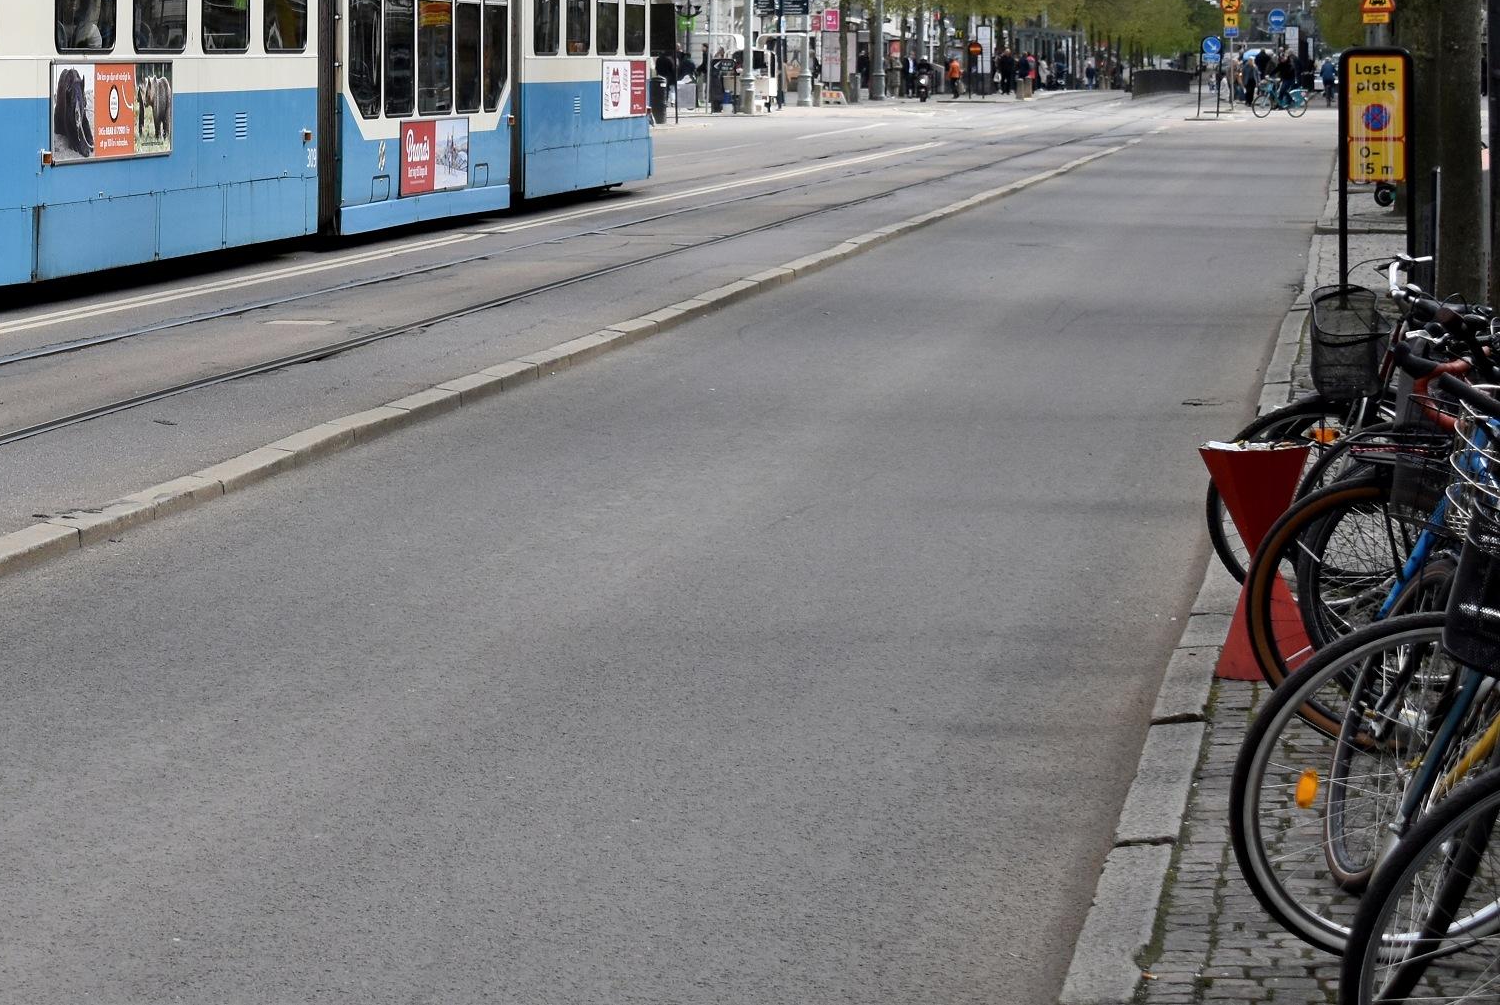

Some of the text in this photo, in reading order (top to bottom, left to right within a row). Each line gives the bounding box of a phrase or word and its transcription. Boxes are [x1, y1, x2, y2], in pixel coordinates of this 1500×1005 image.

[1355, 63, 1396, 75] Last-
[1356, 79, 1396, 94] plats
[1360, 162, 1394, 175] 15 m
